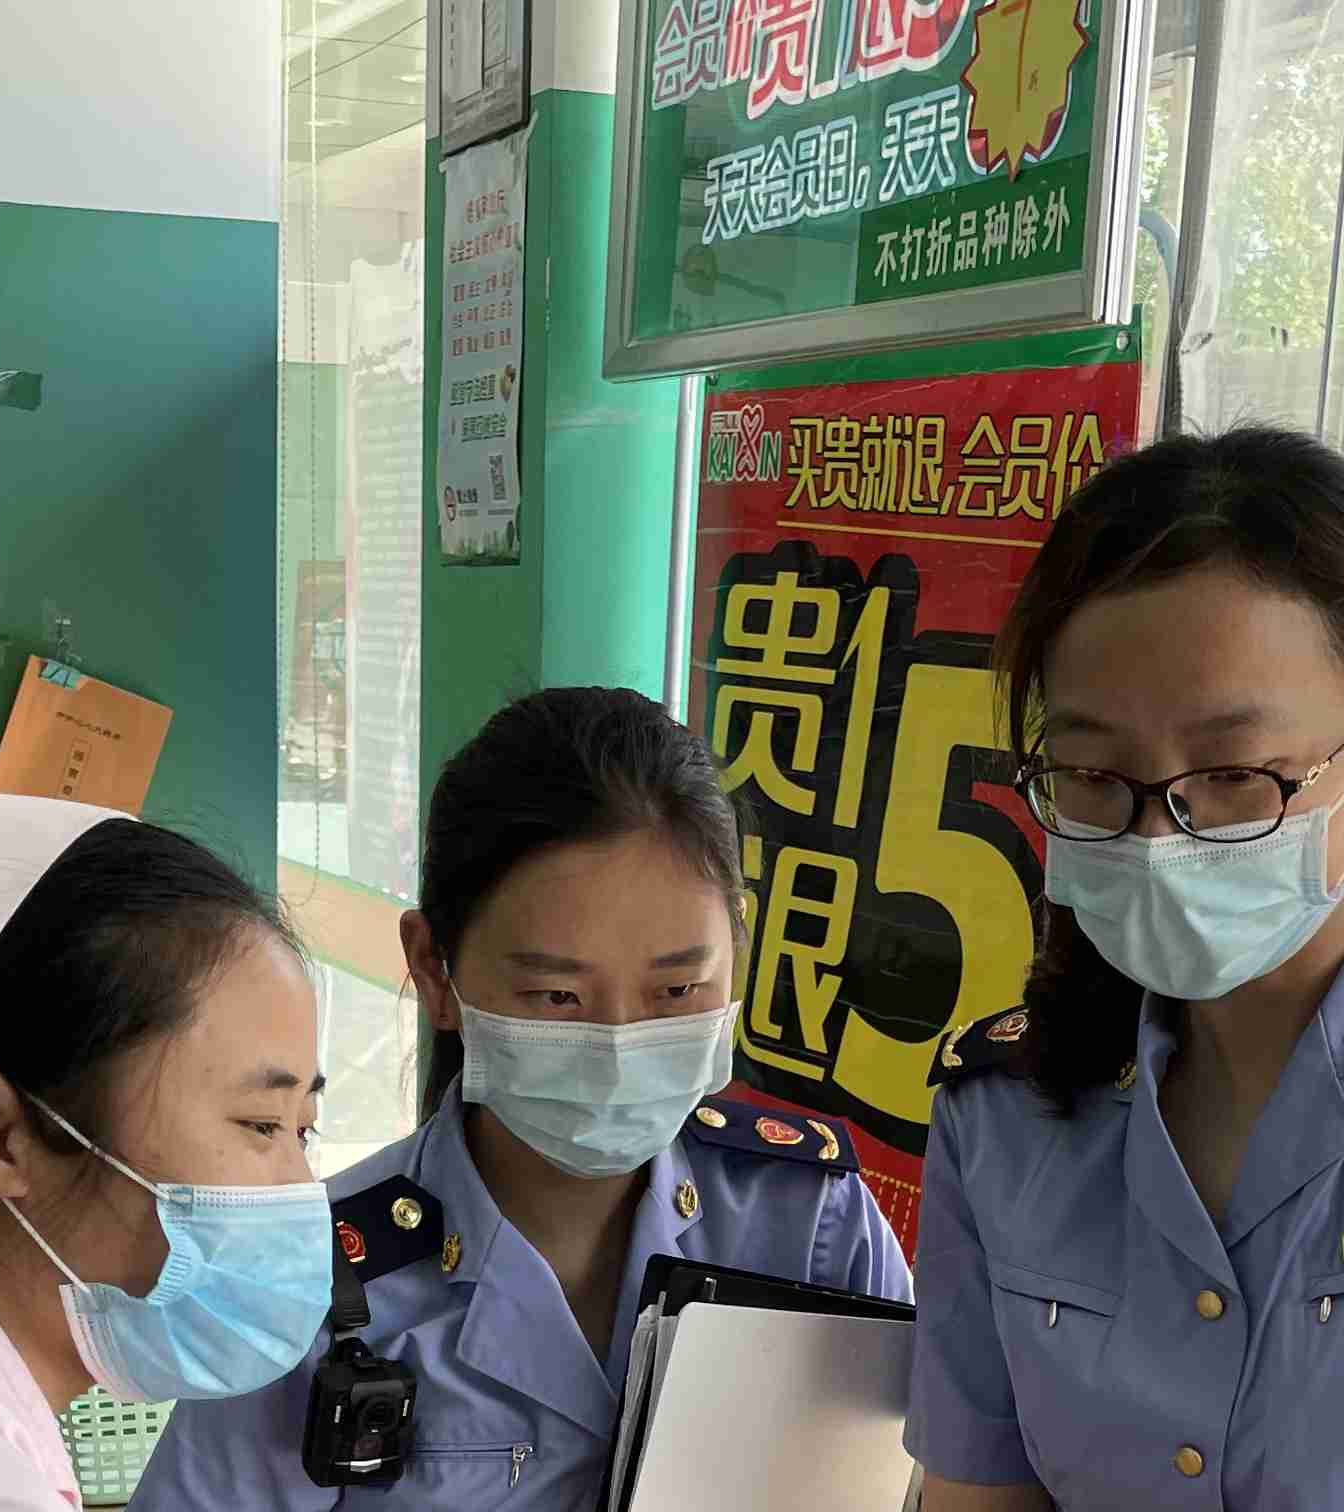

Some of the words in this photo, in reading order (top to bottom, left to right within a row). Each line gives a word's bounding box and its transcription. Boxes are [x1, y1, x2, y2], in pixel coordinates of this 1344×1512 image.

[874, 186, 1072, 287] 不打折品种除外
